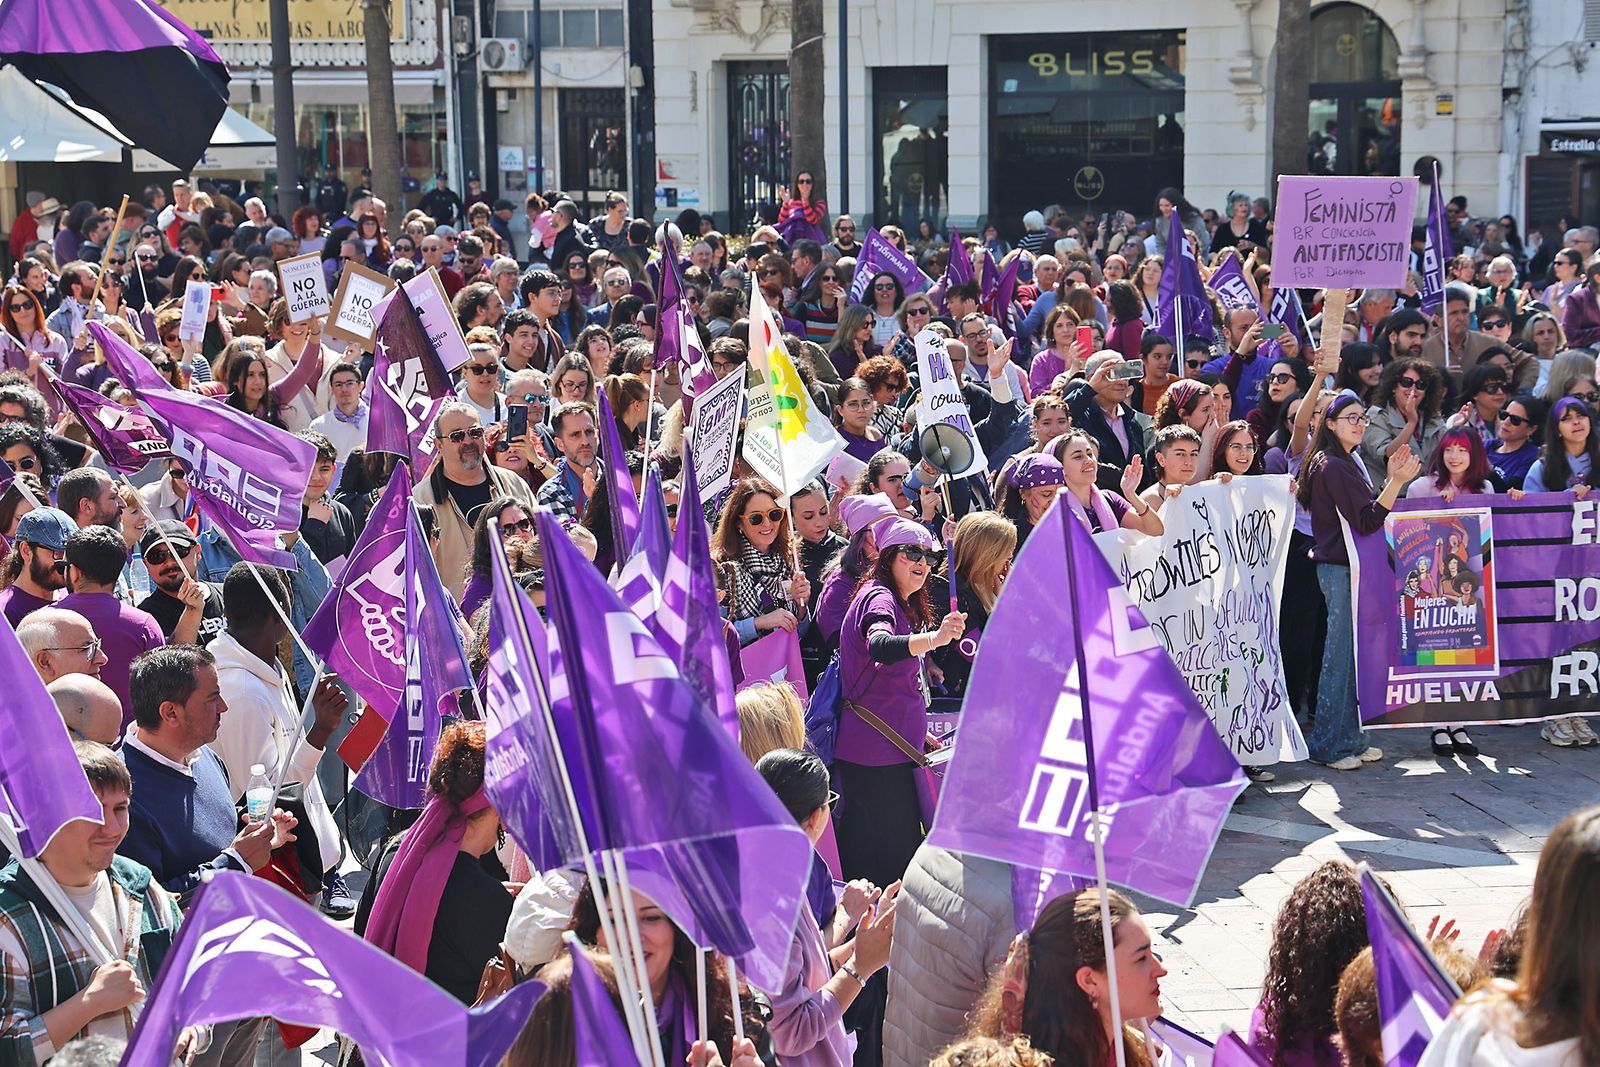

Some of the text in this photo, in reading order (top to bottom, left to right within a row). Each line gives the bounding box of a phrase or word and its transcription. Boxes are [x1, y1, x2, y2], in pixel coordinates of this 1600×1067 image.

[1028, 50, 1153, 76] BLISS
[1551, 138, 1595, 152] Estrella
[292, 277, 315, 293] NO
[306, 291, 316, 299] LA
[352, 293, 372, 310] NO
[291, 297, 327, 312] GUERRA
[340, 311, 371, 328] GUERRA
[359, 309, 367, 318] LA
[1414, 596, 1447, 609] Mujeres
[1413, 605, 1476, 630] EN LUCHA
[1385, 680, 1501, 706] HUELVA
